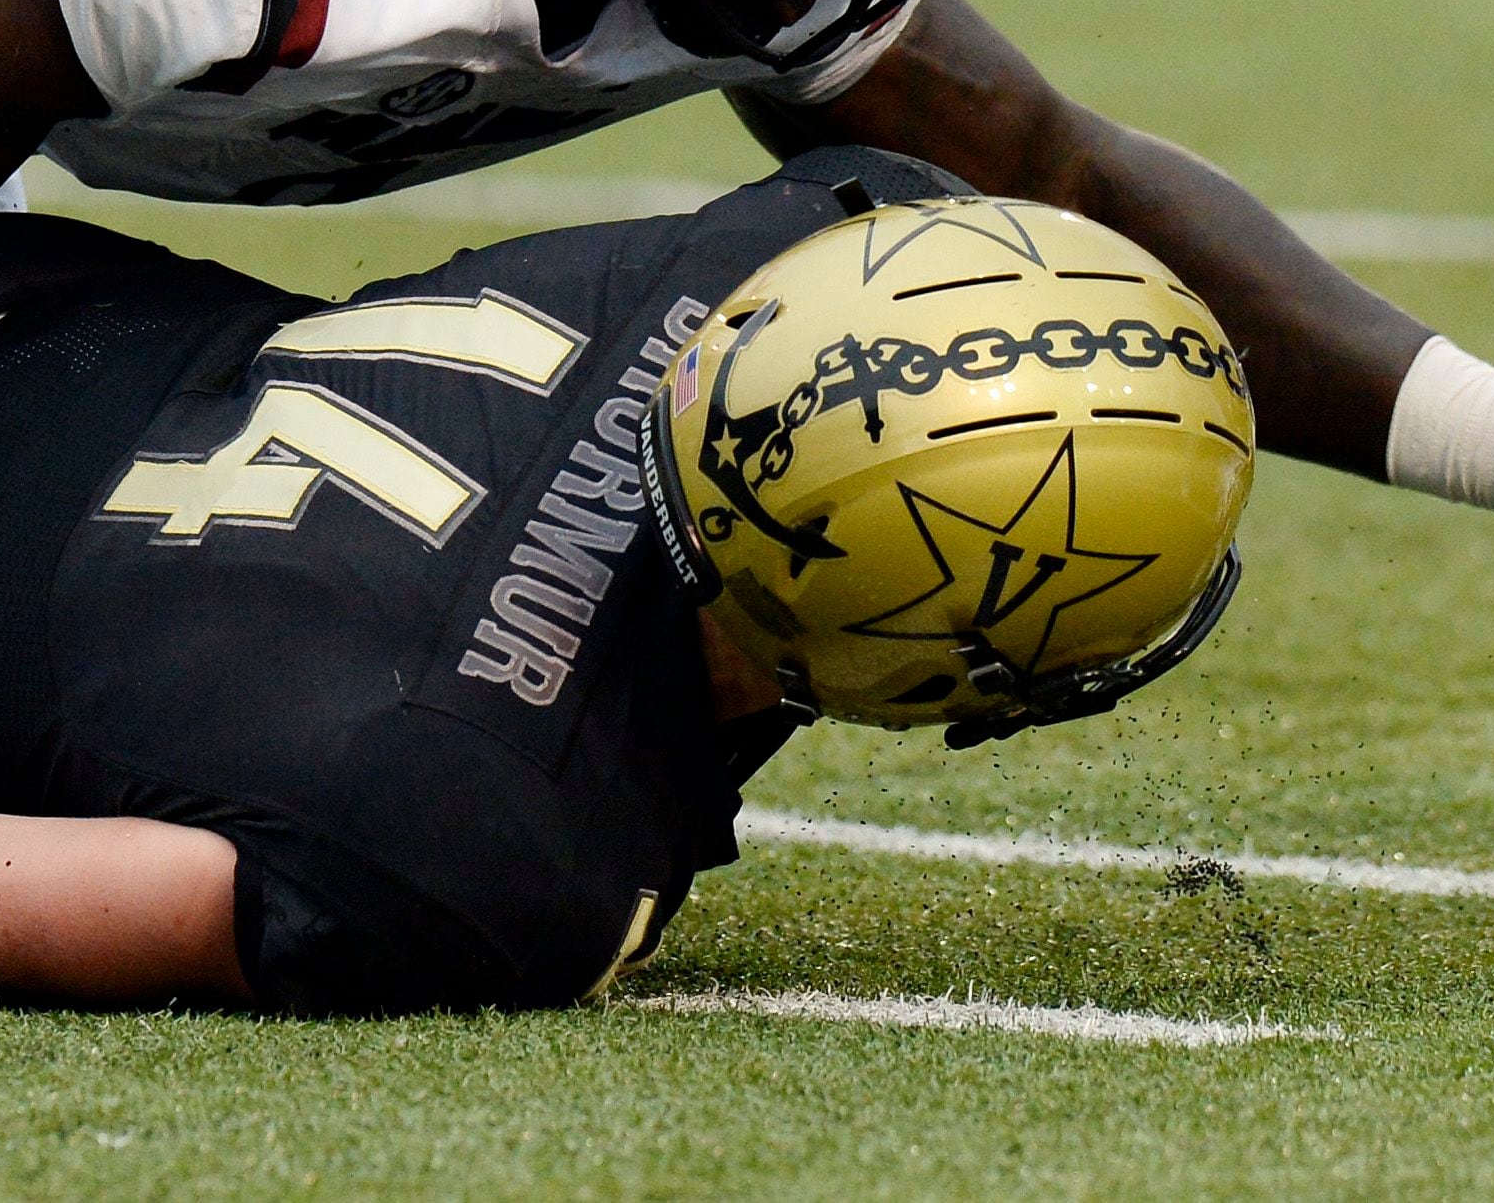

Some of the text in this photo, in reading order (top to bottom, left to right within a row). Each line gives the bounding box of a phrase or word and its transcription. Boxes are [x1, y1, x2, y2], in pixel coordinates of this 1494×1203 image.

[90, 287, 591, 547] 14
[640, 410, 699, 585] VANDERBILT
[972, 540, 1068, 629] V
